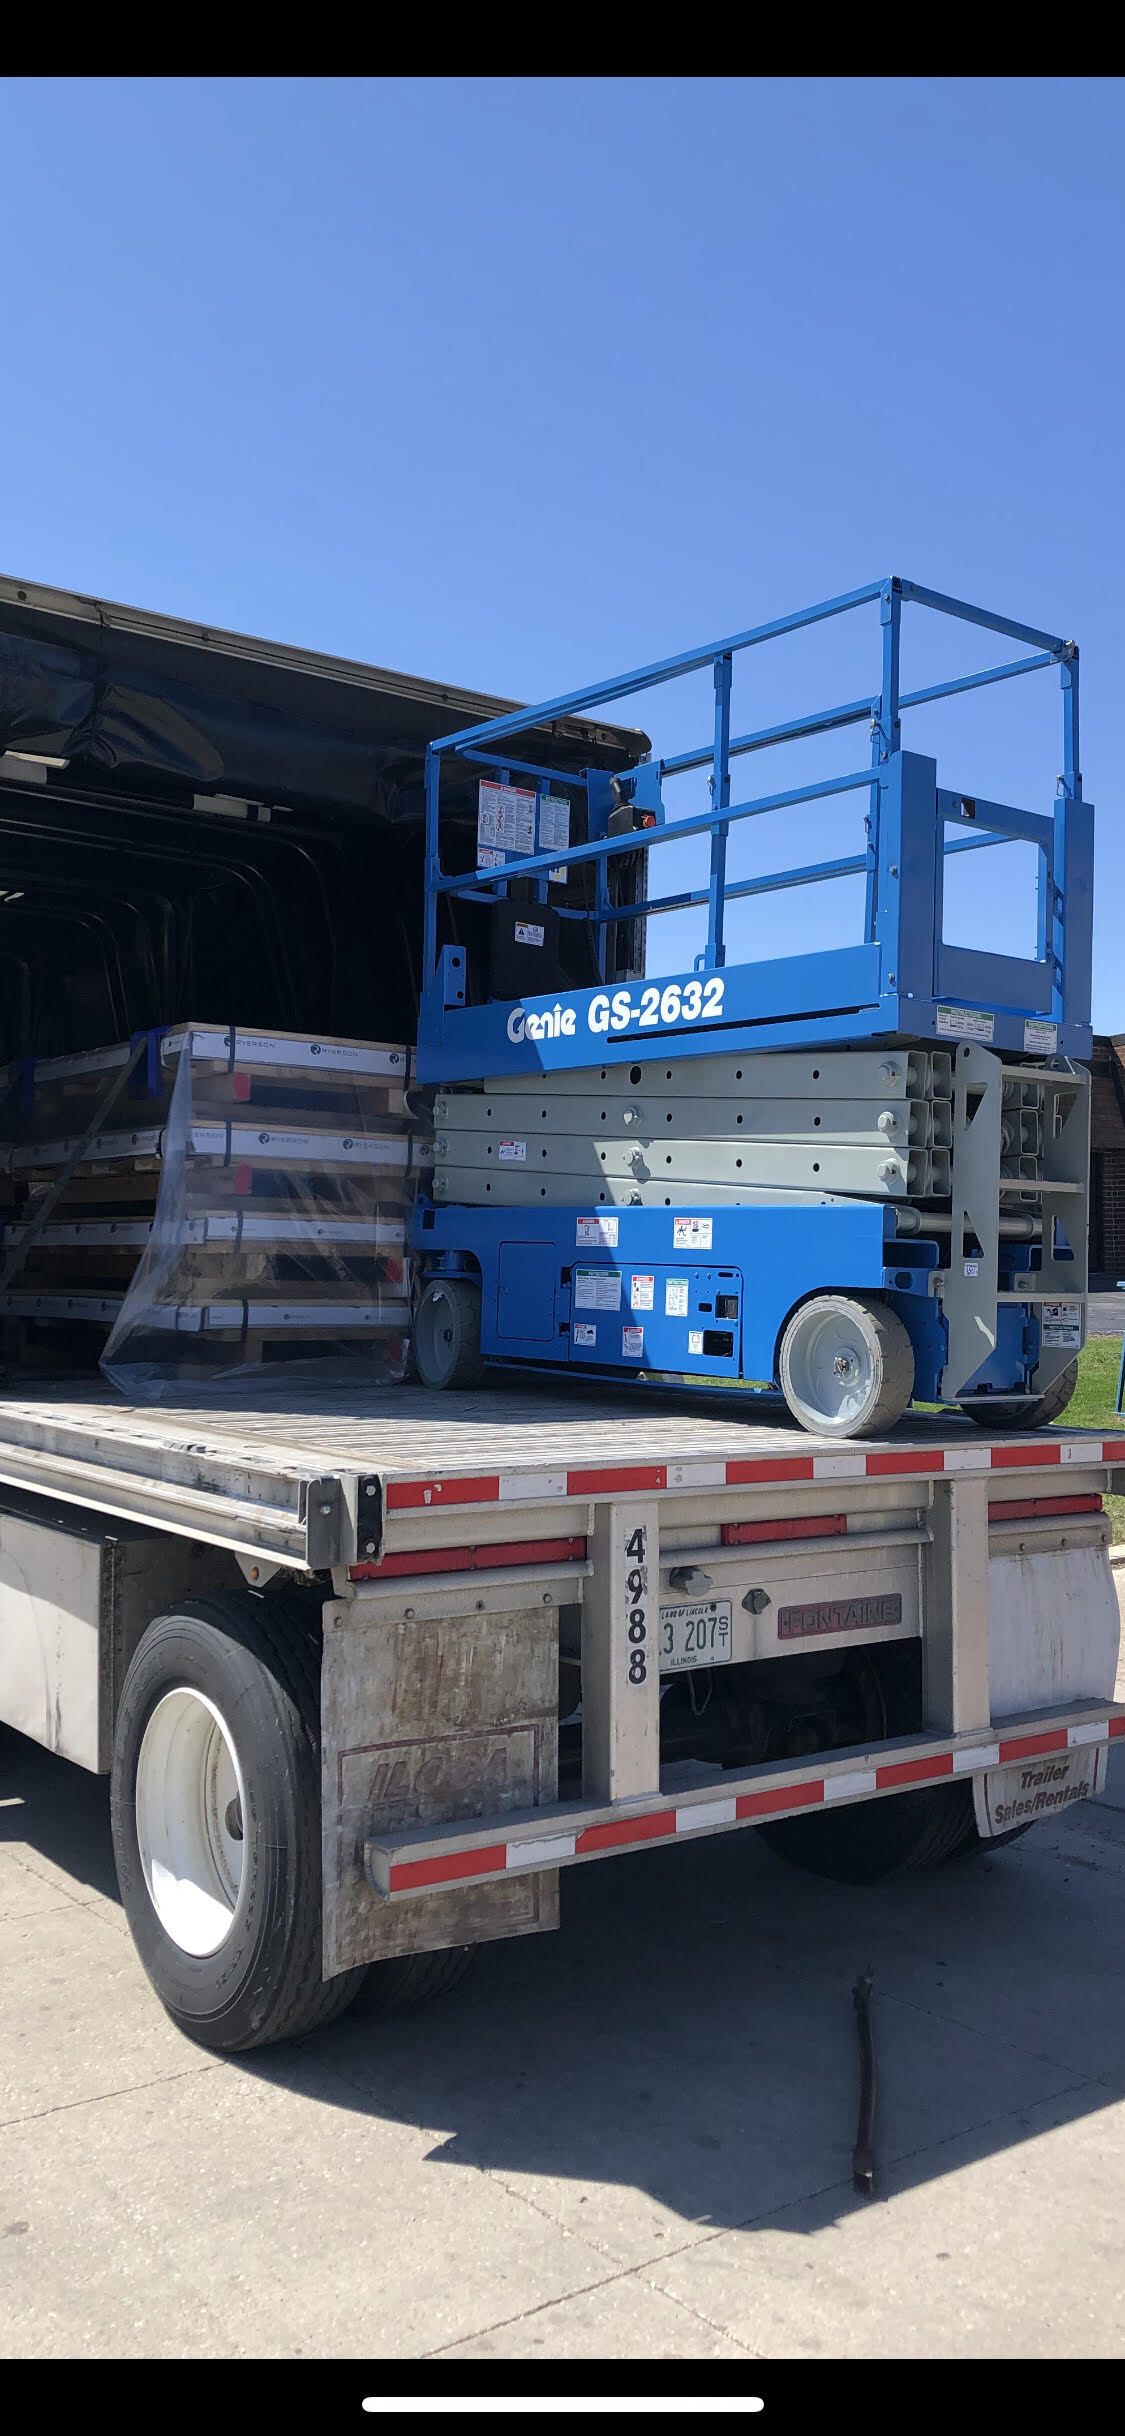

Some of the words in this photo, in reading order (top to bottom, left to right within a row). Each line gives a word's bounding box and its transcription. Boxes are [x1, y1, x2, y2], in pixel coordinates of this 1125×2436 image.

[507, 1003, 576, 1043] Genie
[588, 977, 725, 1033] GS-2632
[236, 1040, 275, 1048] RYERSON
[321, 1048, 359, 1057] RYERSON
[626, 1528, 647, 1684] 4988
[685, 1616, 718, 1652] 207
[670, 1655, 698, 1666] ILLINOIS
[1020, 1765, 1070, 1790] Trailer
[994, 1780, 1090, 1824] Sales/Rentals
